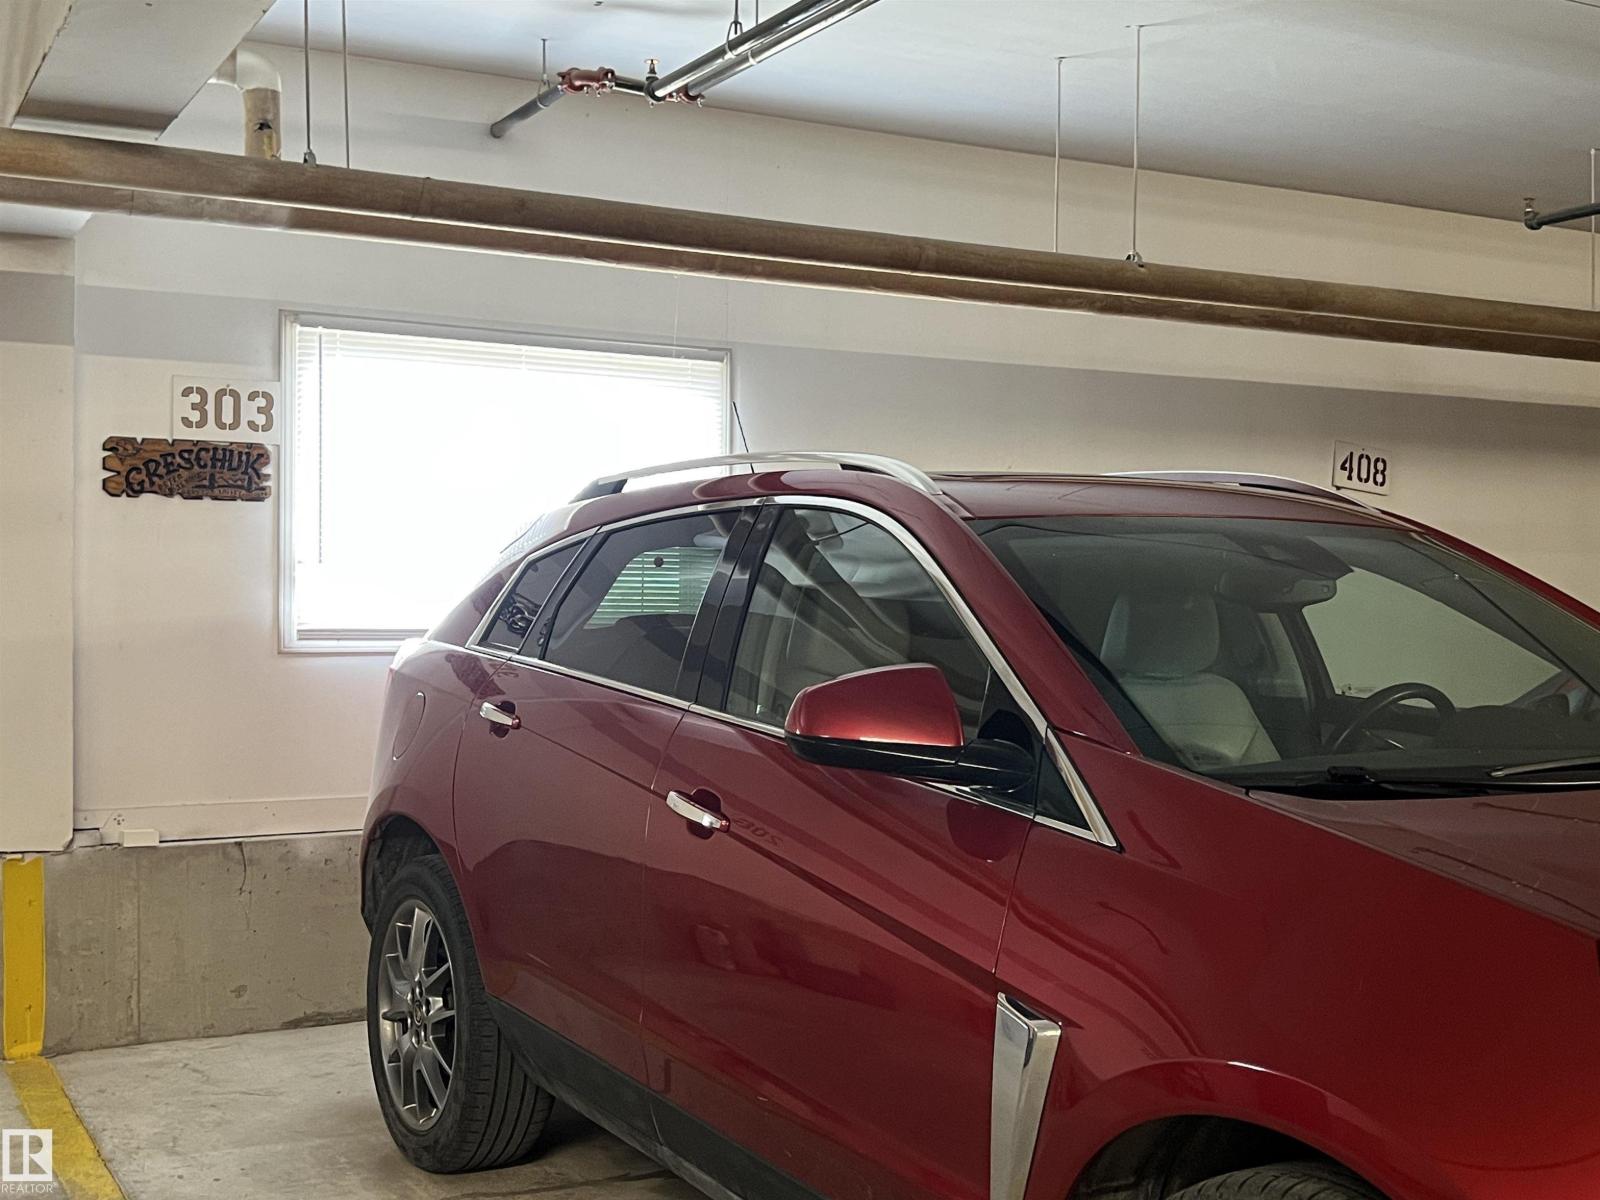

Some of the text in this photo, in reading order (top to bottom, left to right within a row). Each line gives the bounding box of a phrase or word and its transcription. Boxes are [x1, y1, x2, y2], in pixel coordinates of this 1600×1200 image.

[180, 386, 274, 433] 303
[125, 447, 266, 493] GRESCHUK
[1339, 451, 1387, 488] 408
